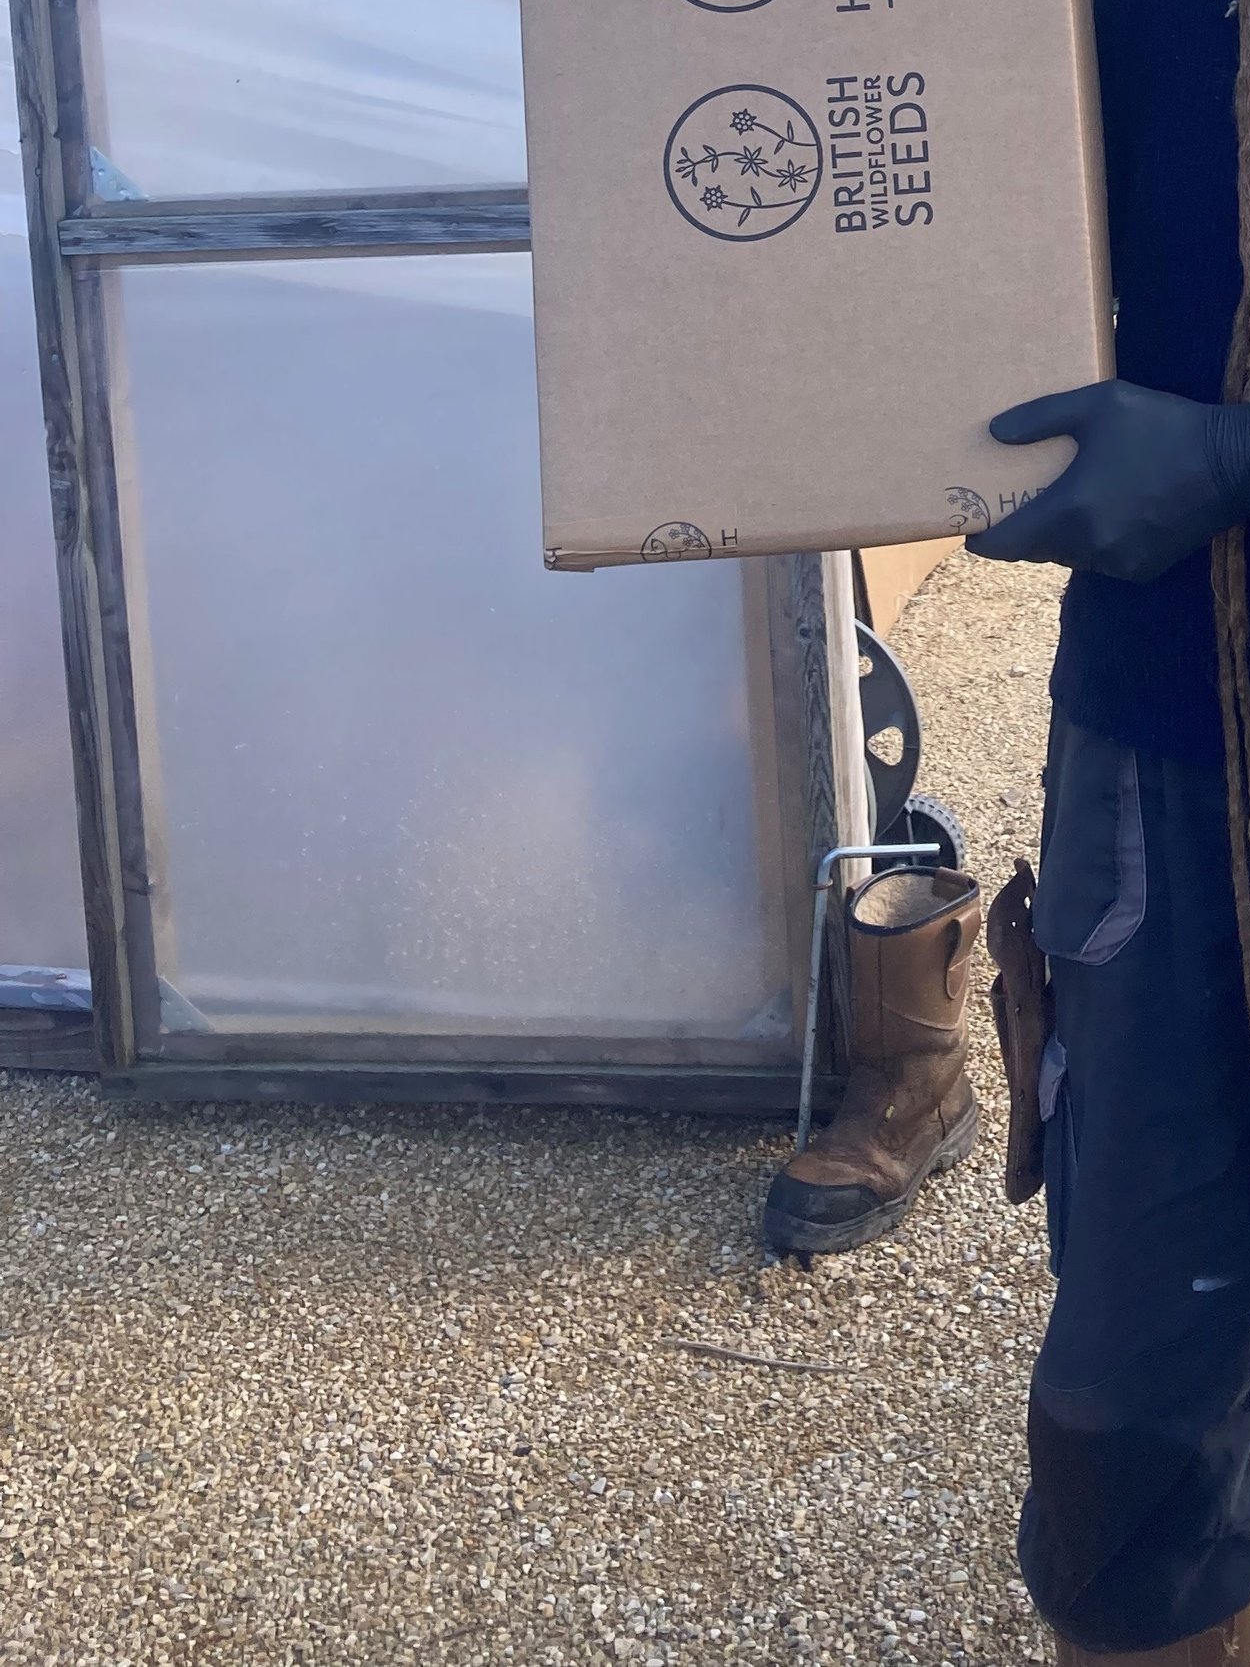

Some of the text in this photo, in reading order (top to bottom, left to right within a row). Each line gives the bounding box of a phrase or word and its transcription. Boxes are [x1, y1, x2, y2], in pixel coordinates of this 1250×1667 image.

[825, 75, 868, 234] BRITISH
[863, 74, 890, 230] WILDFLOWER
[886, 71, 934, 227] SEEDS
